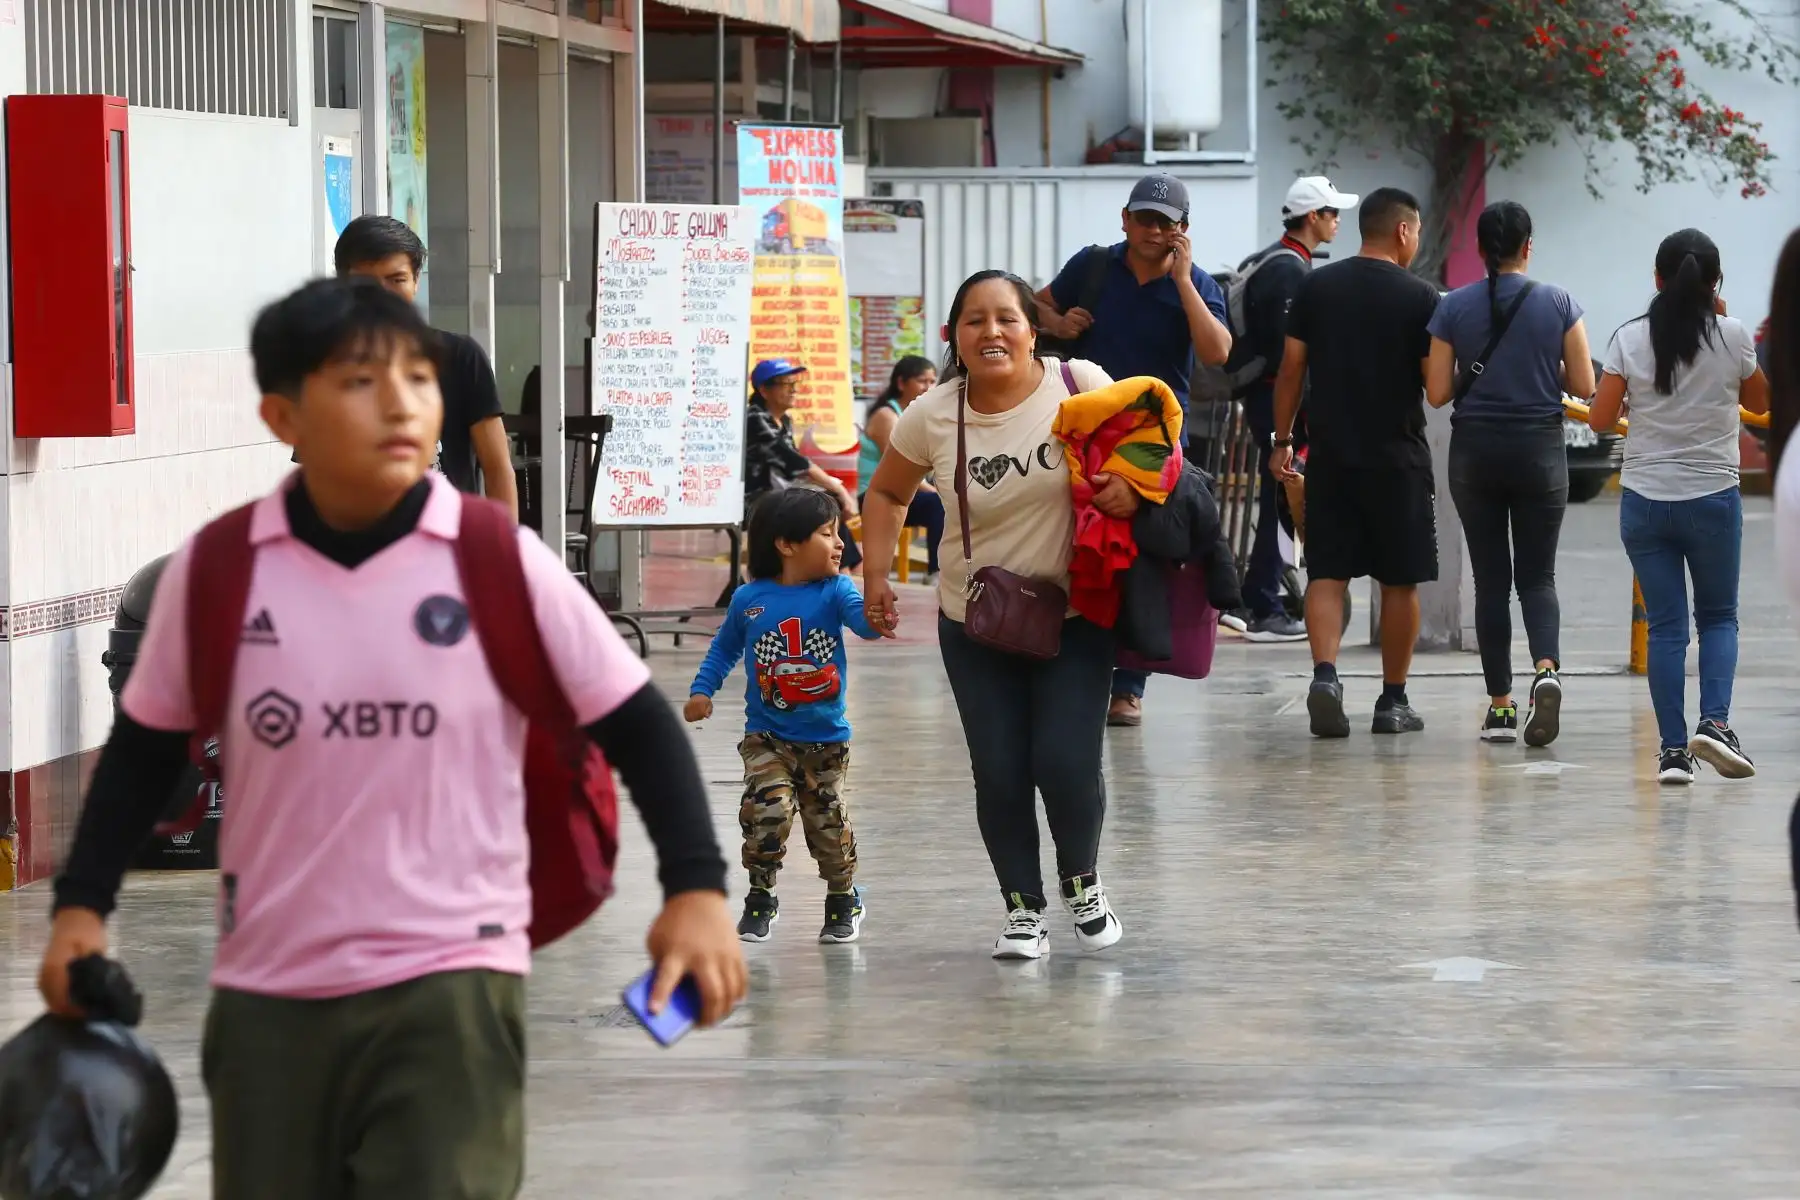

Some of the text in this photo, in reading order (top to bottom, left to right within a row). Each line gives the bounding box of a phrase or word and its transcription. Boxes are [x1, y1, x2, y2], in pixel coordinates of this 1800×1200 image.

[761, 128, 837, 157] EXPRESS
[768, 159, 837, 186] MOLINA
[619, 207, 728, 241] CALDO DE GALLINA
[611, 469, 654, 487] FESTIVAL
[622, 485, 634, 498] DE
[608, 494, 669, 518] SALCHIPAPAS
[778, 617, 802, 657] 1
[320, 700, 438, 739] XBTO
